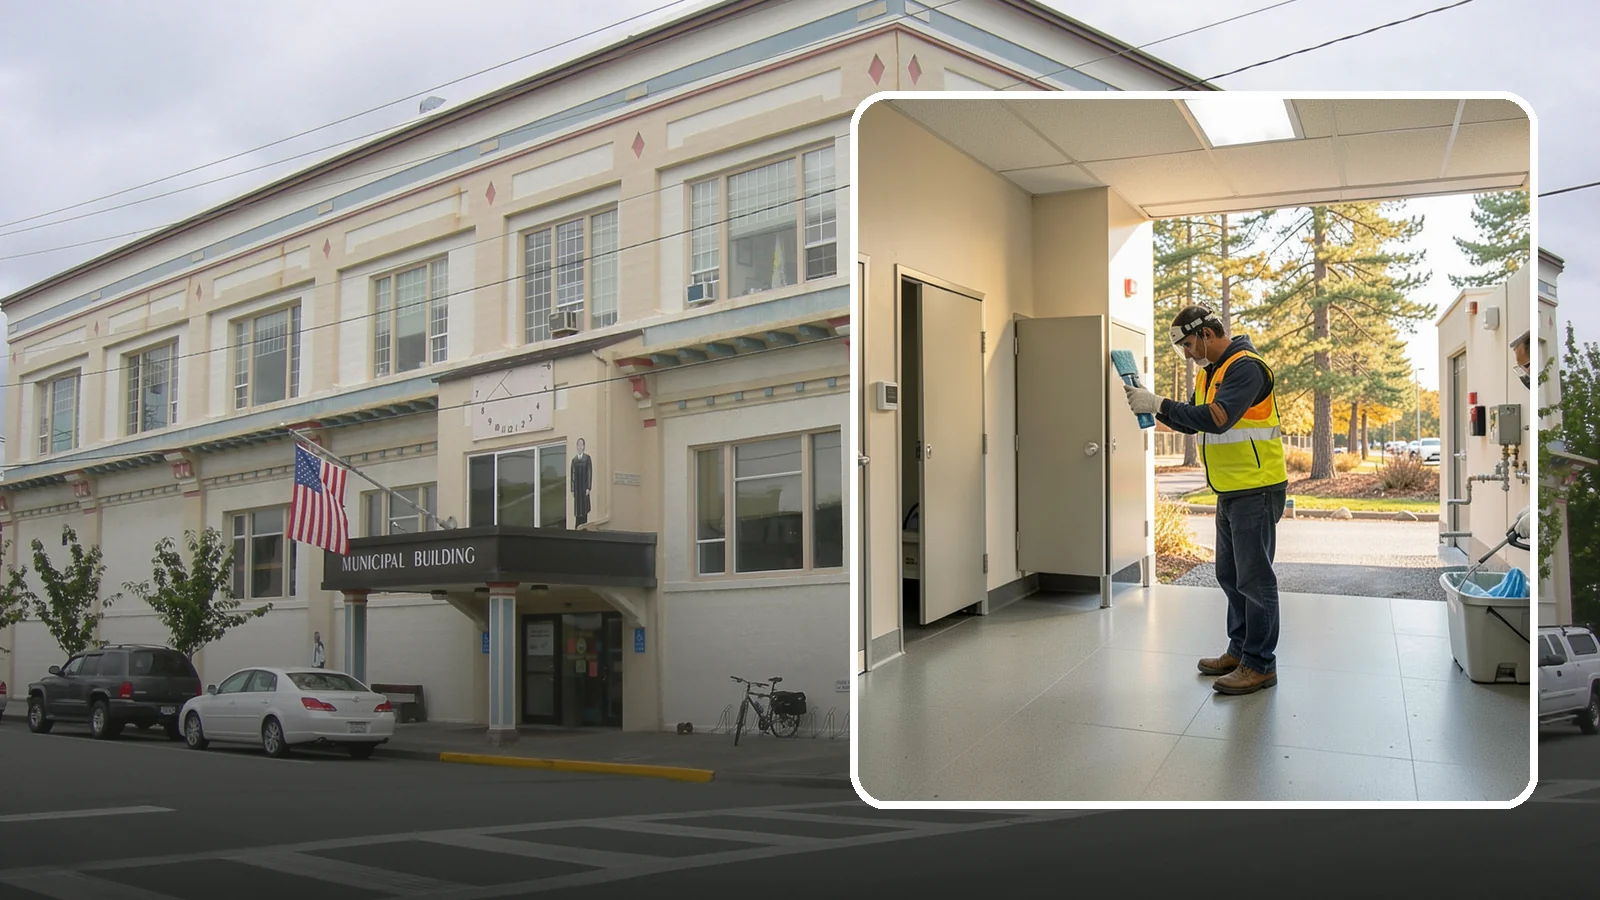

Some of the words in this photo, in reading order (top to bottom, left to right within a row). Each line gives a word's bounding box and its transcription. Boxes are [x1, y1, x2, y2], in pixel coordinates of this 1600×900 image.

[480, 407, 484, 415] 8
[488, 418, 492, 426] 9
[494, 424, 500, 432] 10
[342, 552, 405, 572] MUNICIPAL
[414, 546, 475, 567] BUILDING
